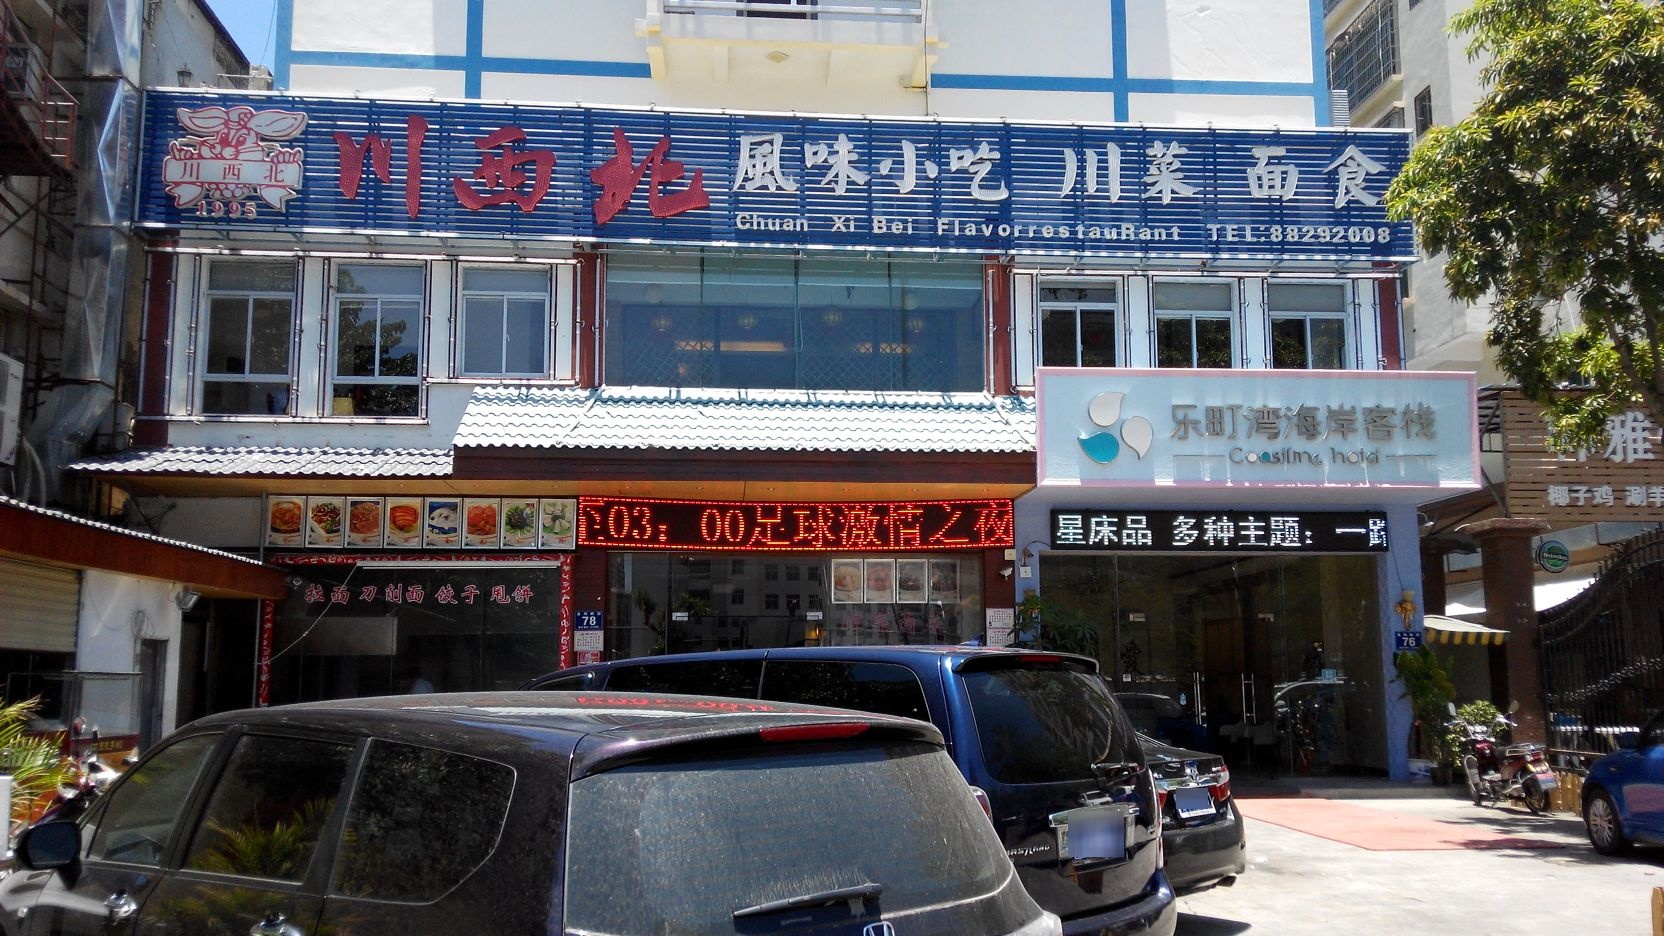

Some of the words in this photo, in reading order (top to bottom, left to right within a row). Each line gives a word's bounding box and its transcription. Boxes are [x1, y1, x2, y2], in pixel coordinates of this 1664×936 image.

[180, 161, 285, 183] 川西北
[733, 132, 1010, 201] 風味小吃
[1060, 140, 1200, 205] 川菜
[196, 200, 257, 219] 1995
[735, 213, 809, 232] Chuan
[831, 215, 856, 233] Xi
[872, 216, 913, 235] Bei
[1207, 223, 1391, 244] TEL:88292008
[1170, 402, 1437, 440] 乐町湾海岸客栈
[1056, 514, 1153, 546] 星床品
[304, 583, 350, 605] 拉面
[435, 583, 481, 605] 饺子
[582, 616, 597, 626] 78
[1401, 636, 1417, 648] 76
